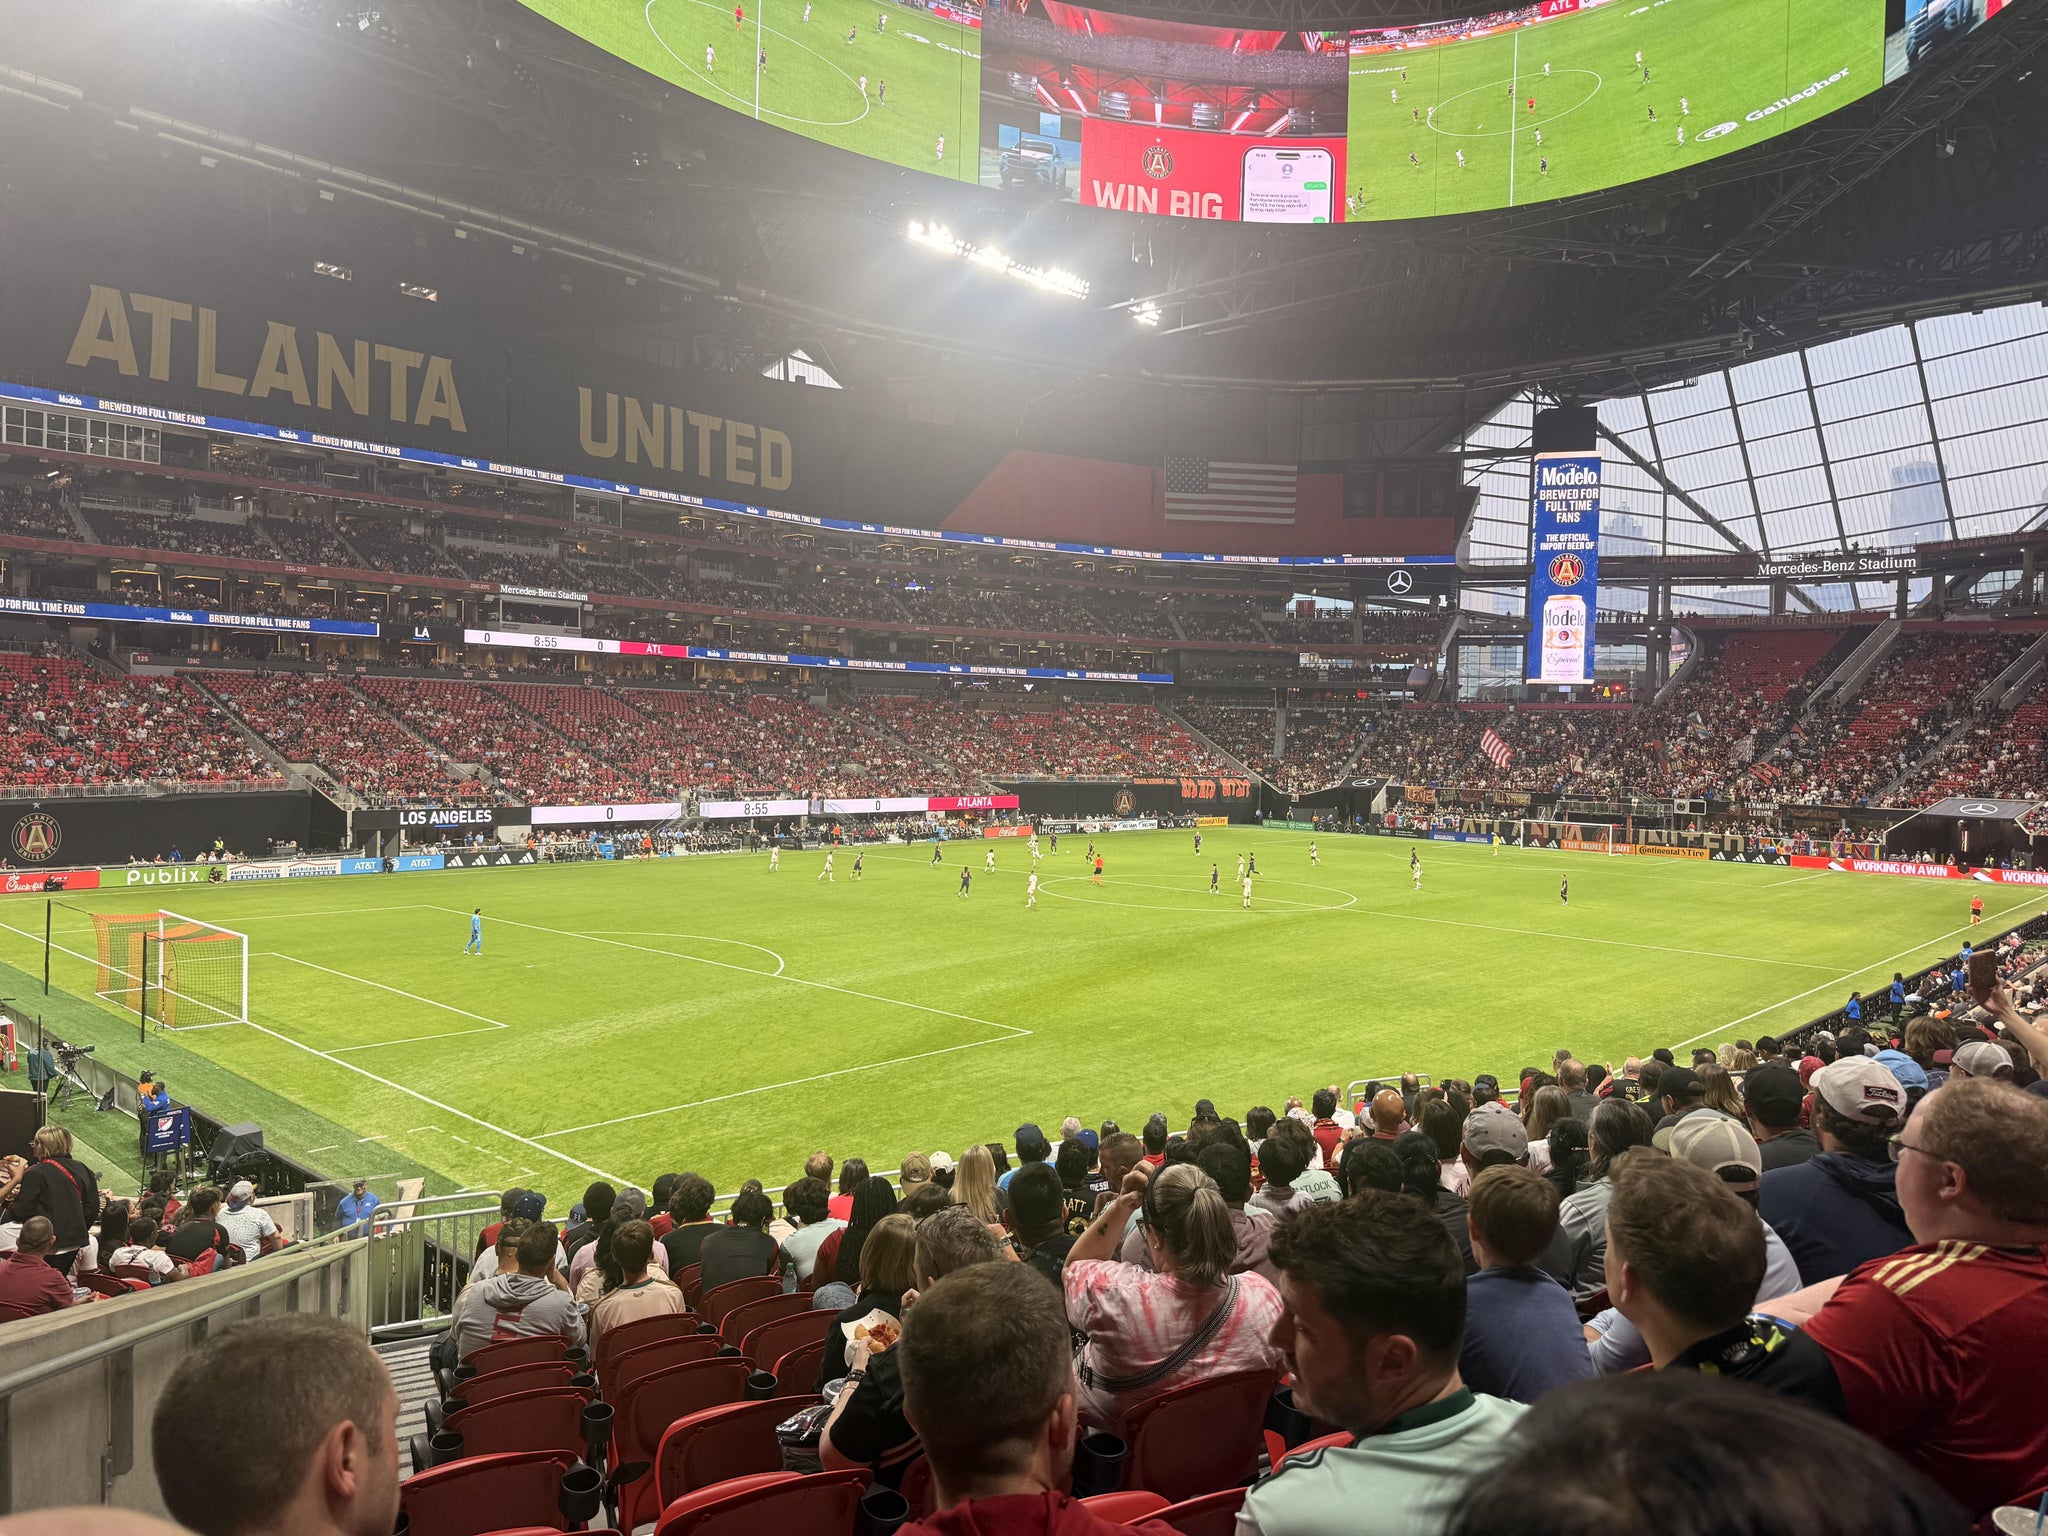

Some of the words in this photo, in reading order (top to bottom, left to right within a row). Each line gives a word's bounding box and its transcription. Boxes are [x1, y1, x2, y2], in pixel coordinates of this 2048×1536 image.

[1745, 67, 1850, 122] Gallagher
[1093, 180, 1158, 214] WIN
[1170, 190, 1223, 219] BIG
[66, 284, 468, 433] ATLANTA
[59, 394, 82, 405] Modelo
[99, 400, 131, 413] BREWED
[133, 405, 148, 416] FOR
[149, 407, 167, 420] FULL
[168, 411, 186, 422] TIME
[187, 414, 205, 425] FANS
[312, 434, 339, 446] BREWED
[340, 439, 352, 448] FOR
[353, 441, 368, 451] FULL
[369, 443, 384, 453] TIME
[385, 445, 400, 455] FANS
[578, 386, 793, 491] UNITED
[489, 463, 512, 473] BREWED
[513, 466, 523, 475] FOR
[524, 468, 536, 478] FULL
[537, 471, 550, 480] TIME
[550, 472, 564, 482] FANS
[1542, 467, 1598, 486] Modelo
[1540, 489, 1578, 500] BREWED
[1580, 488, 1599, 499] FOR
[1545, 501, 1567, 511] FULL
[1569, 500, 1592, 511] TIME
[1556, 512, 1580, 523] FANS
[1546, 534, 1559, 542] THE
[1560, 533, 1589, 542] OFFICIAL
[1567, 542, 1584, 550] BEER
[1758, 560, 1855, 576] Mercedes-Benz
[1859, 557, 1917, 570] Stadium
[500, 585, 556, 598] Mercedes-Benz
[558, 590, 588, 601] Stadium
[6, 599, 21, 610] FOR
[22, 600, 40, 611] FULL
[41, 602, 62, 612] TIME
[64, 604, 85, 614] FANS
[171, 612, 192, 621] Modelo
[209, 614, 240, 624] BREWED
[241, 616, 256, 625] FOR
[257, 617, 274, 627] FULL
[274, 618, 291, 628] TIME
[292, 620, 310, 629] FANS
[415, 627, 430, 638] LA
[485, 633, 490, 643] 0
[534, 636, 557, 647] 8:55
[598, 641, 603, 650] 0
[646, 643, 663, 654] ATL
[875, 801, 880, 812] 0
[957, 797, 993, 808] ATLANTA
[1744, 801, 1779, 810] TERMINUS
[606, 807, 613, 820] 0
[744, 803, 768, 815] 8:55
[20, 814, 54, 827] ATLANTA
[400, 811, 426, 825] LOS
[430, 810, 492, 824] ANGELES
[1039, 824, 1054, 834] IHG
[1581, 842, 1604, 850] HOME
[1639, 846, 1680, 857] Continental
[1687, 848, 1705, 857] Tire
[18, 847, 45, 860] UNITED
[47, 845, 57, 855] FC
[354, 861, 377, 871] AT&T
[410, 858, 432, 868] AT&T
[1854, 861, 1900, 874] WORKING
[1902, 864, 1912, 874] ON
[1918, 866, 1924, 875] A
[1925, 866, 1947, 877] WIN
[127, 867, 200, 886] Publix
[2002, 872, 2048, 885] WORKIN
[6, 876, 44, 892] Chick-fil
[1292, 1180, 1331, 1193] TLOCK
